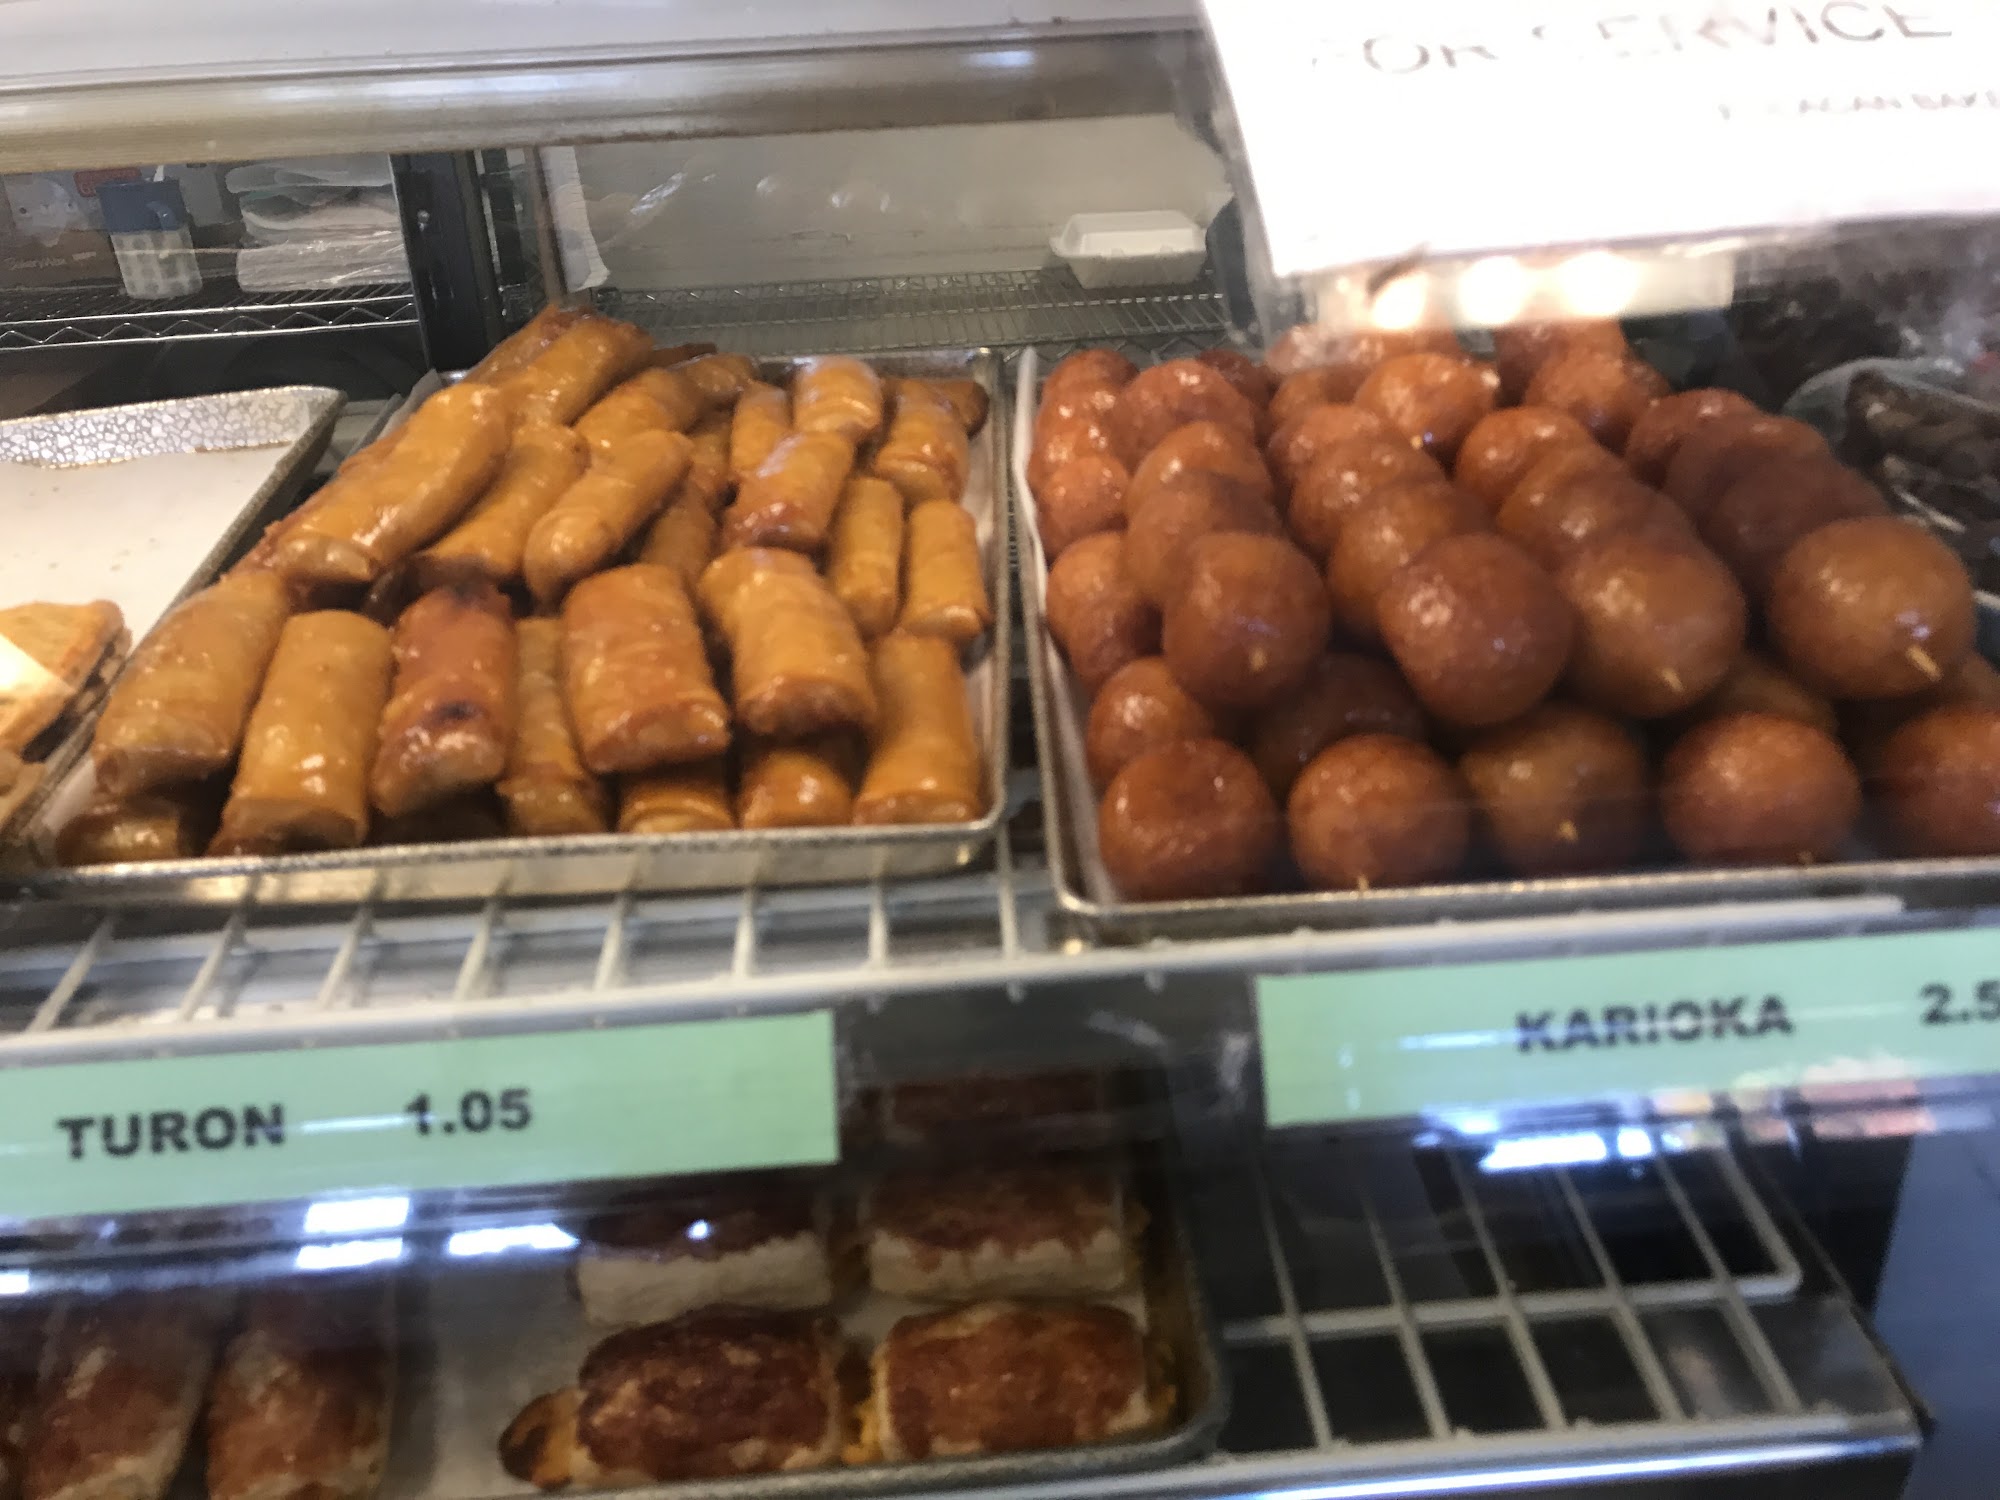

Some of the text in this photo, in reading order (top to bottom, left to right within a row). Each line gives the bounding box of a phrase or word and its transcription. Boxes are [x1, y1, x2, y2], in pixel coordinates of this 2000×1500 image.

[1515, 995, 1794, 1052] KARIOKA
[57, 1088, 530, 1160] TURON 1.05
